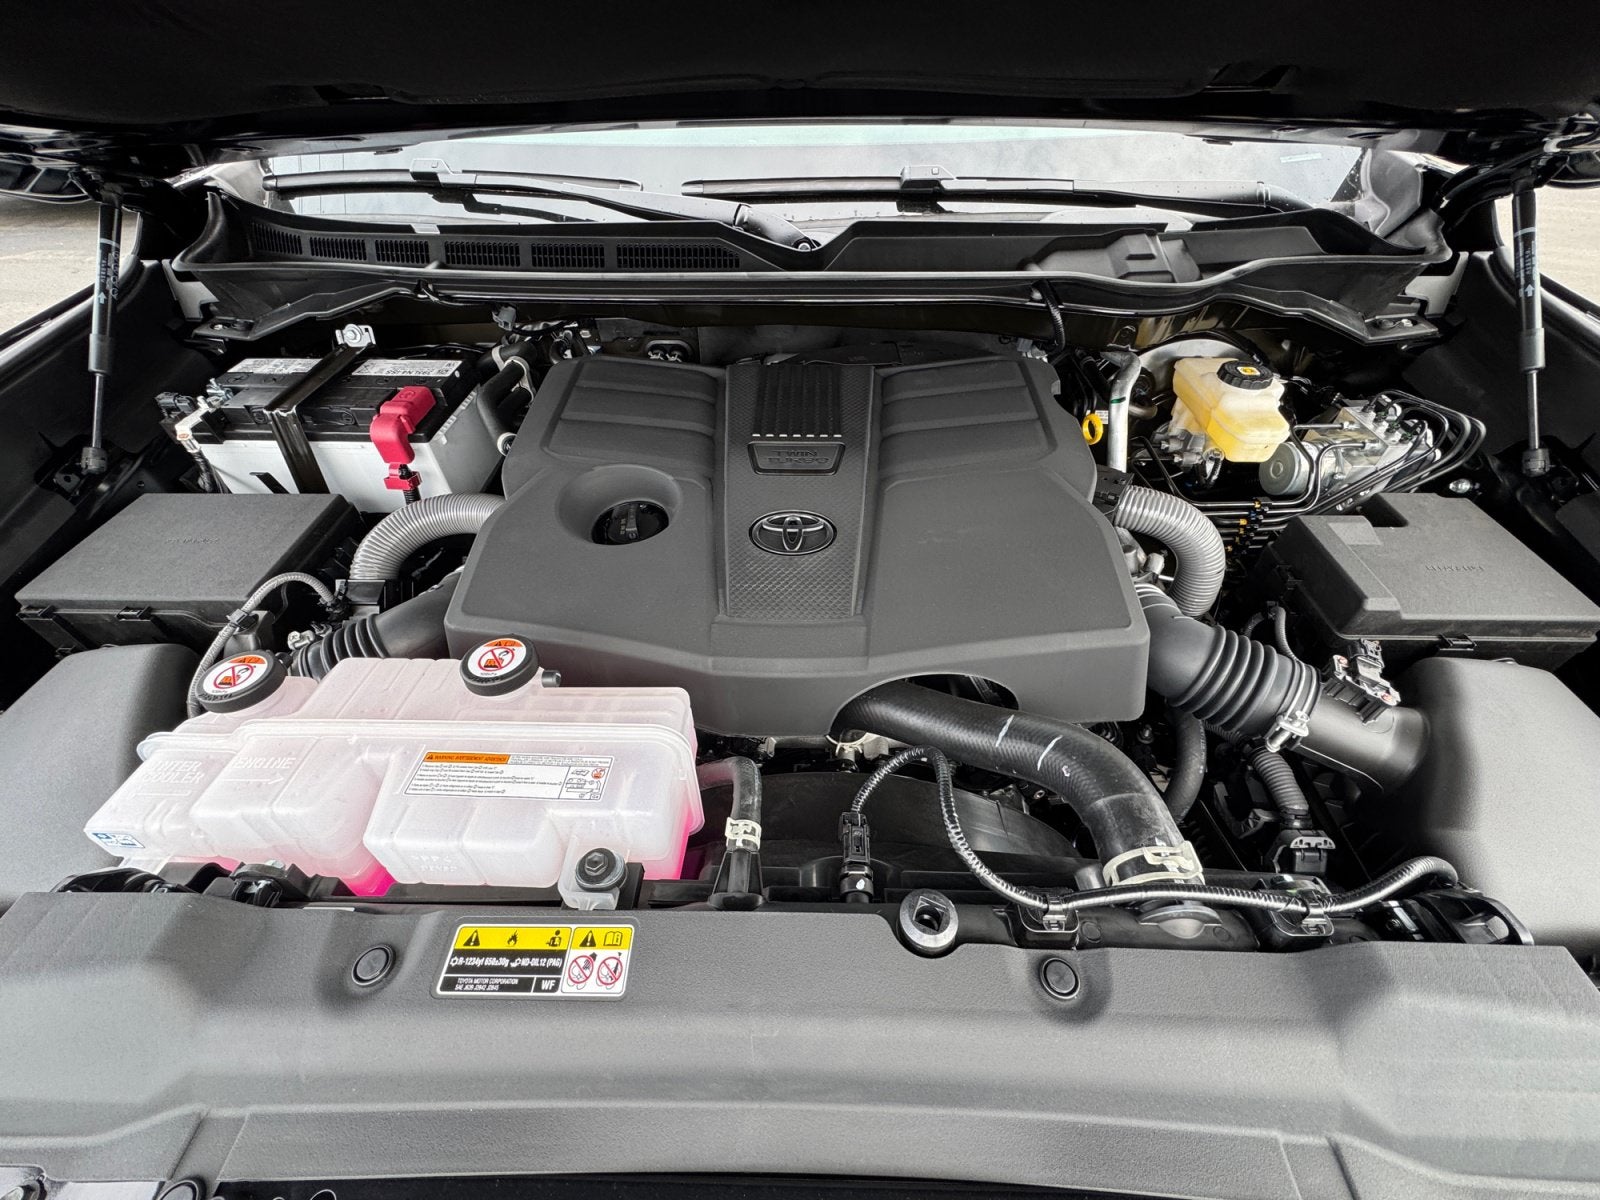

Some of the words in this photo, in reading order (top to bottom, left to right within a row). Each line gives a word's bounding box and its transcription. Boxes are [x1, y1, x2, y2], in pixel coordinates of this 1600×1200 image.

[771, 449, 818, 457] TWIN
[151, 760, 202, 772] INTER
[234, 757, 297, 769] ENGINE
[142, 771, 205, 784] COOLER
[546, 958, 562, 968] (PAG)
[541, 980, 556, 990] WF
